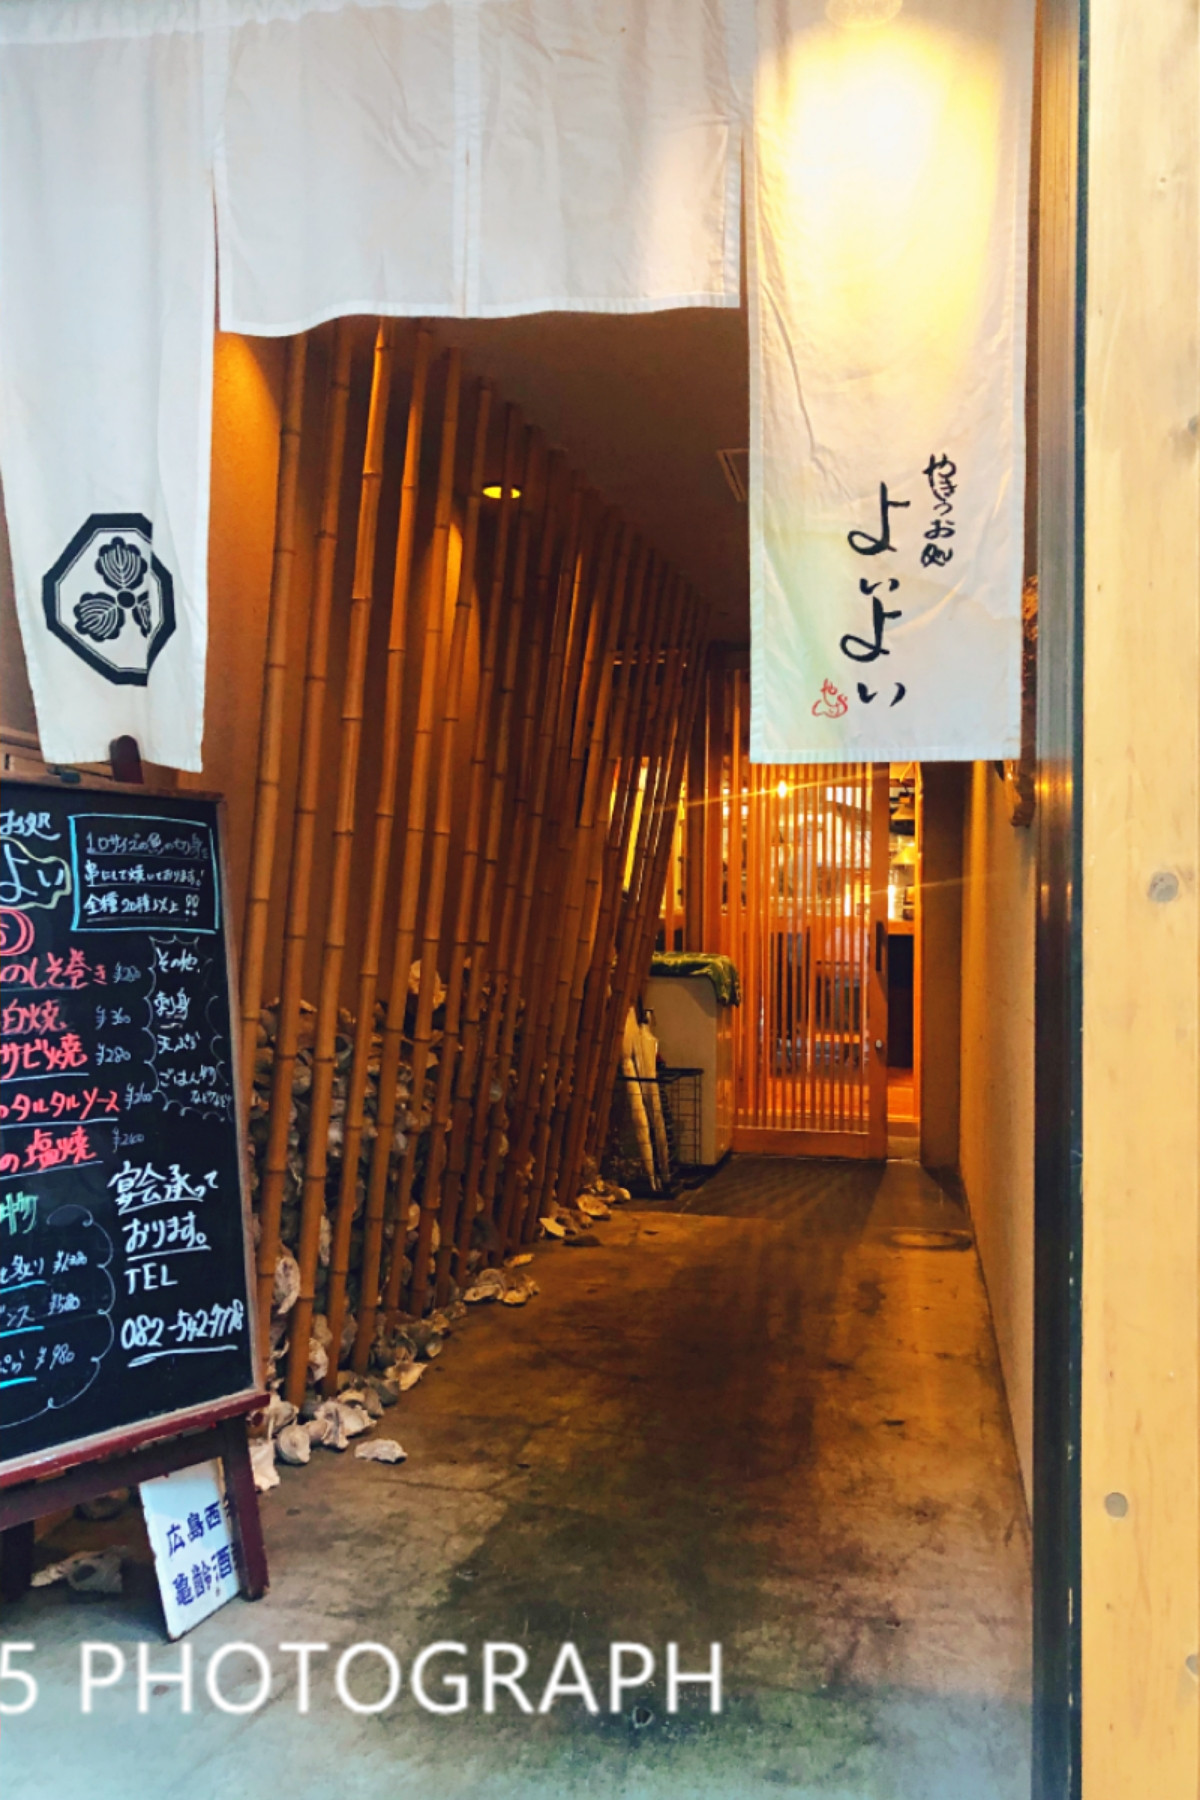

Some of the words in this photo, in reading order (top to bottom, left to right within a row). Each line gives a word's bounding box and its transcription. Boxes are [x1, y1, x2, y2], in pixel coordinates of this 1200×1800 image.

[840, 481, 911, 707] よいよい
[124, 1262, 178, 1295] TEL
[34, 1342, 76, 1372] ¥980
